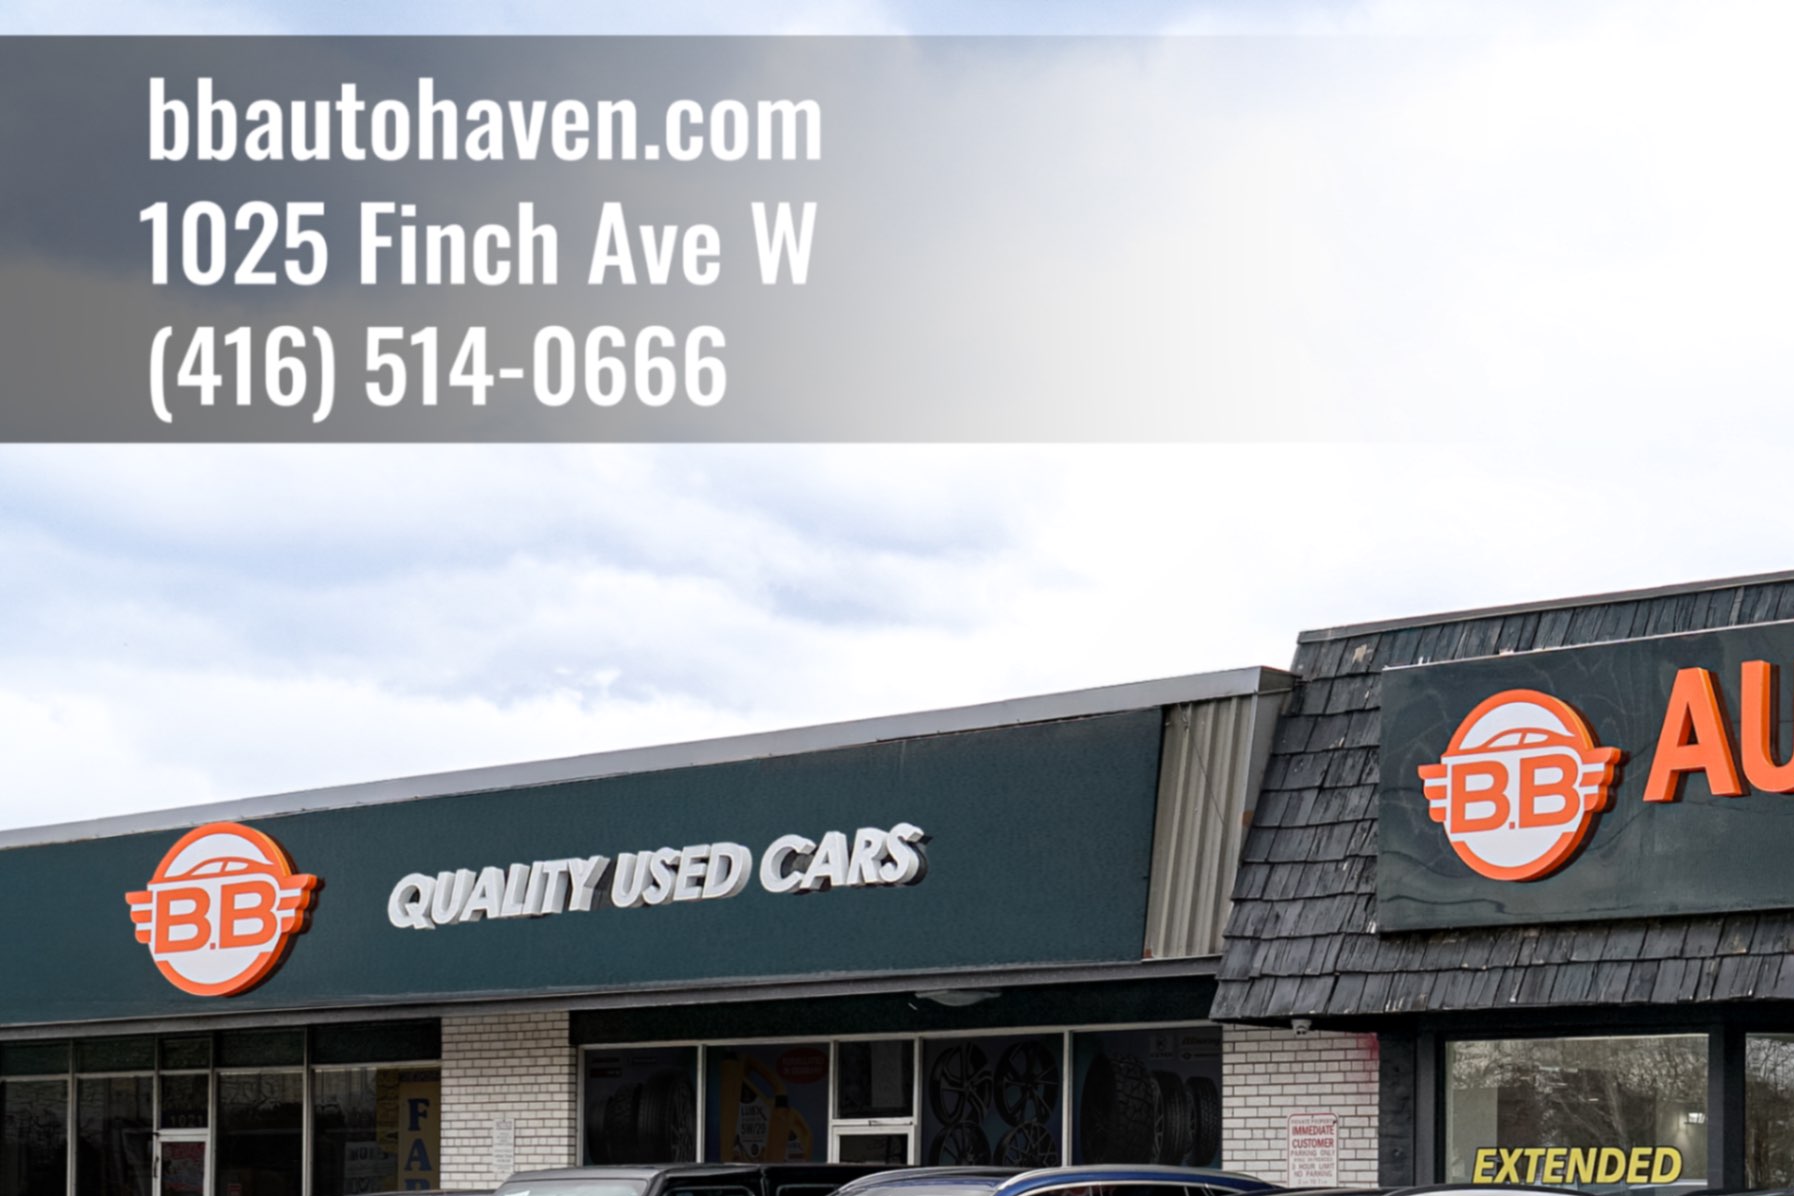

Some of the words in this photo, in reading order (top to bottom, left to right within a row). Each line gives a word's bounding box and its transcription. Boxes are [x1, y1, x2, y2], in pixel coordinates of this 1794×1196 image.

[387, 855, 610, 930] QUALITY
[609, 841, 753, 910] USED
[758, 822, 928, 894] CARS
[1292, 1125, 1334, 1136] IMMEDIATE
[1292, 1138, 1334, 1148] CUSTOMER
[1472, 1146, 1683, 1184] EXTENDED
